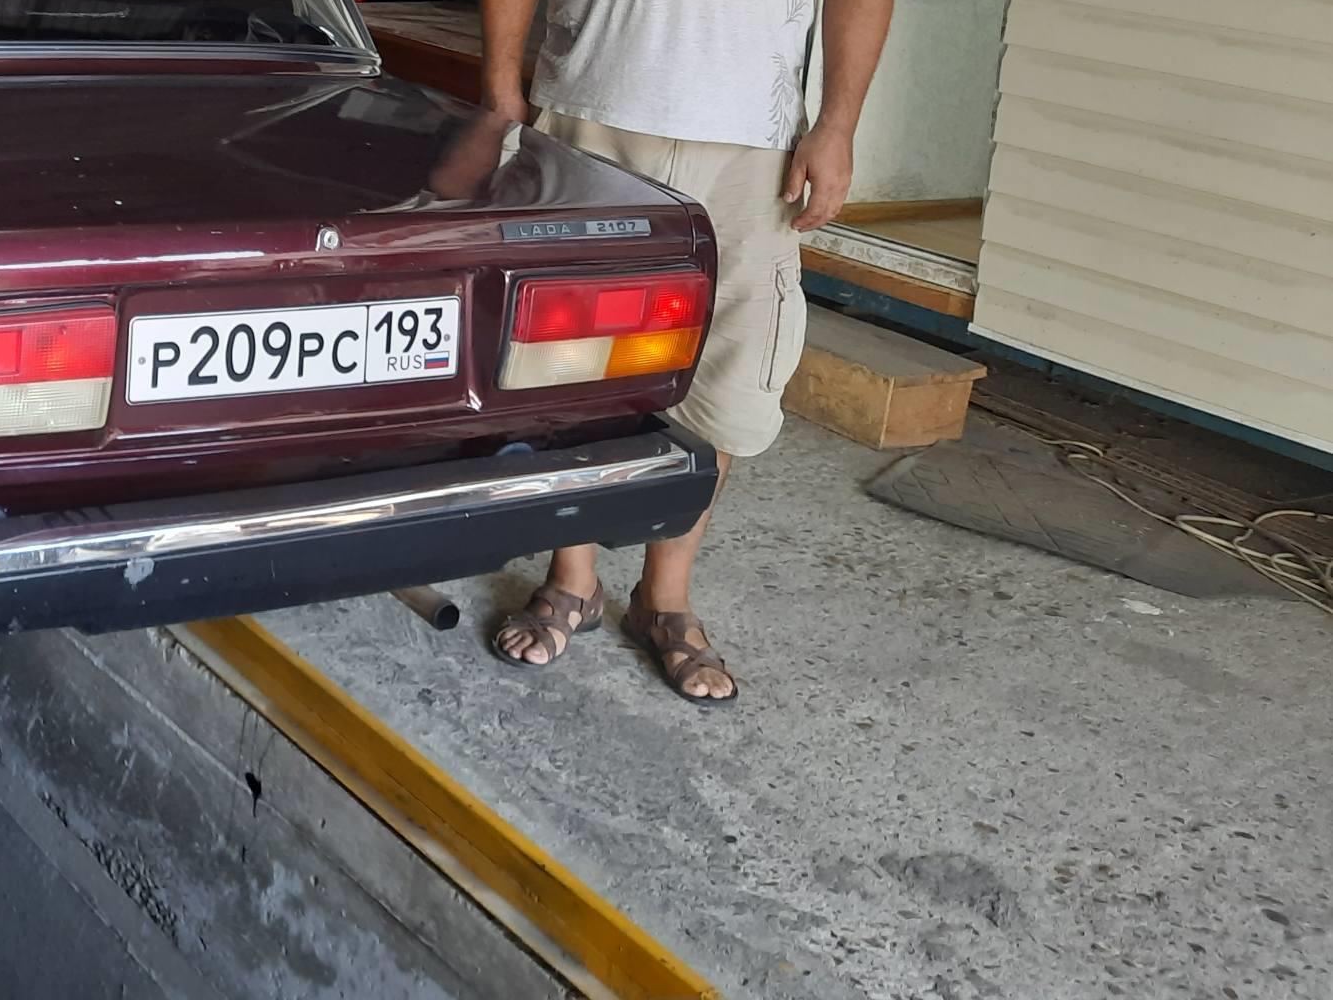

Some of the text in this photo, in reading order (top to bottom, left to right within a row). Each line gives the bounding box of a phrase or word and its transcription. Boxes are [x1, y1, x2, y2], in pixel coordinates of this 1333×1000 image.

[519, 221, 636, 236] LADA 2107
[374, 307, 443, 354] 193
[386, 354, 422, 371] RUS
